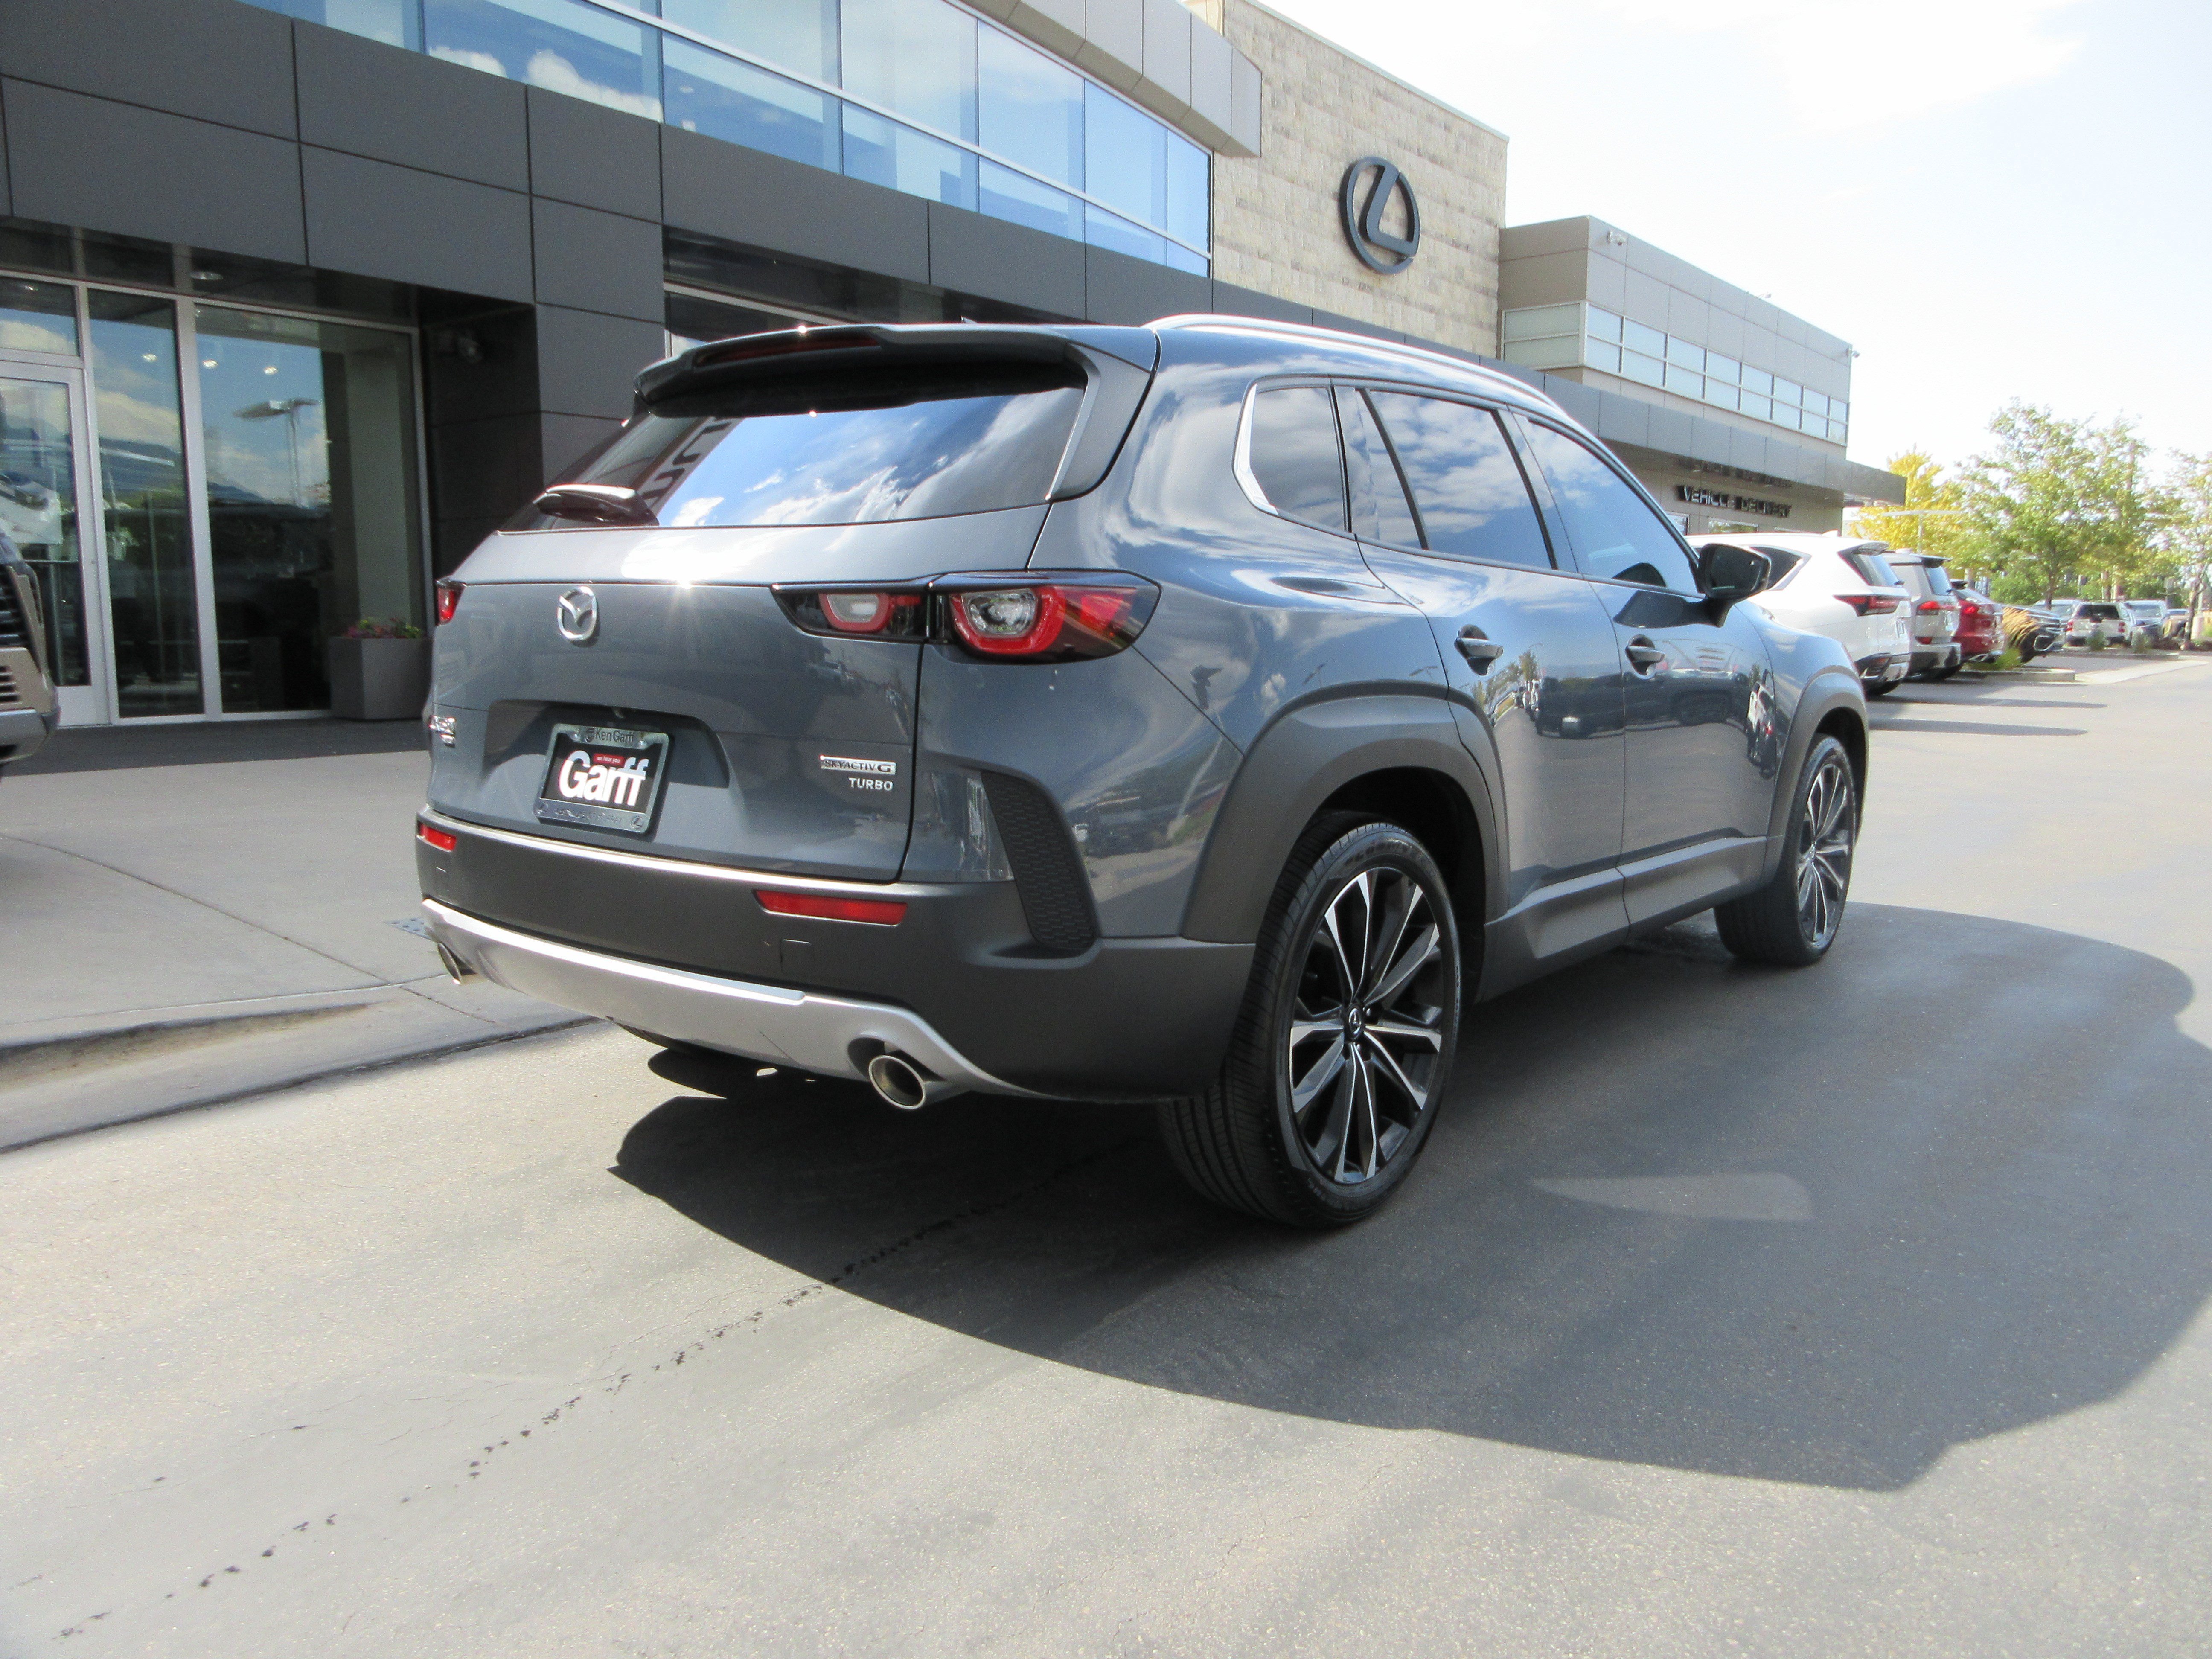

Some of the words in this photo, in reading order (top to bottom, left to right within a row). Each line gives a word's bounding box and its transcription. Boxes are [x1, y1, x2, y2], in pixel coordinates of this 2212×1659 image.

[596, 728, 612, 741] Ken
[613, 730, 635, 744] Garff
[559, 750, 649, 806] Garff
[848, 777, 893, 791] TURBO
